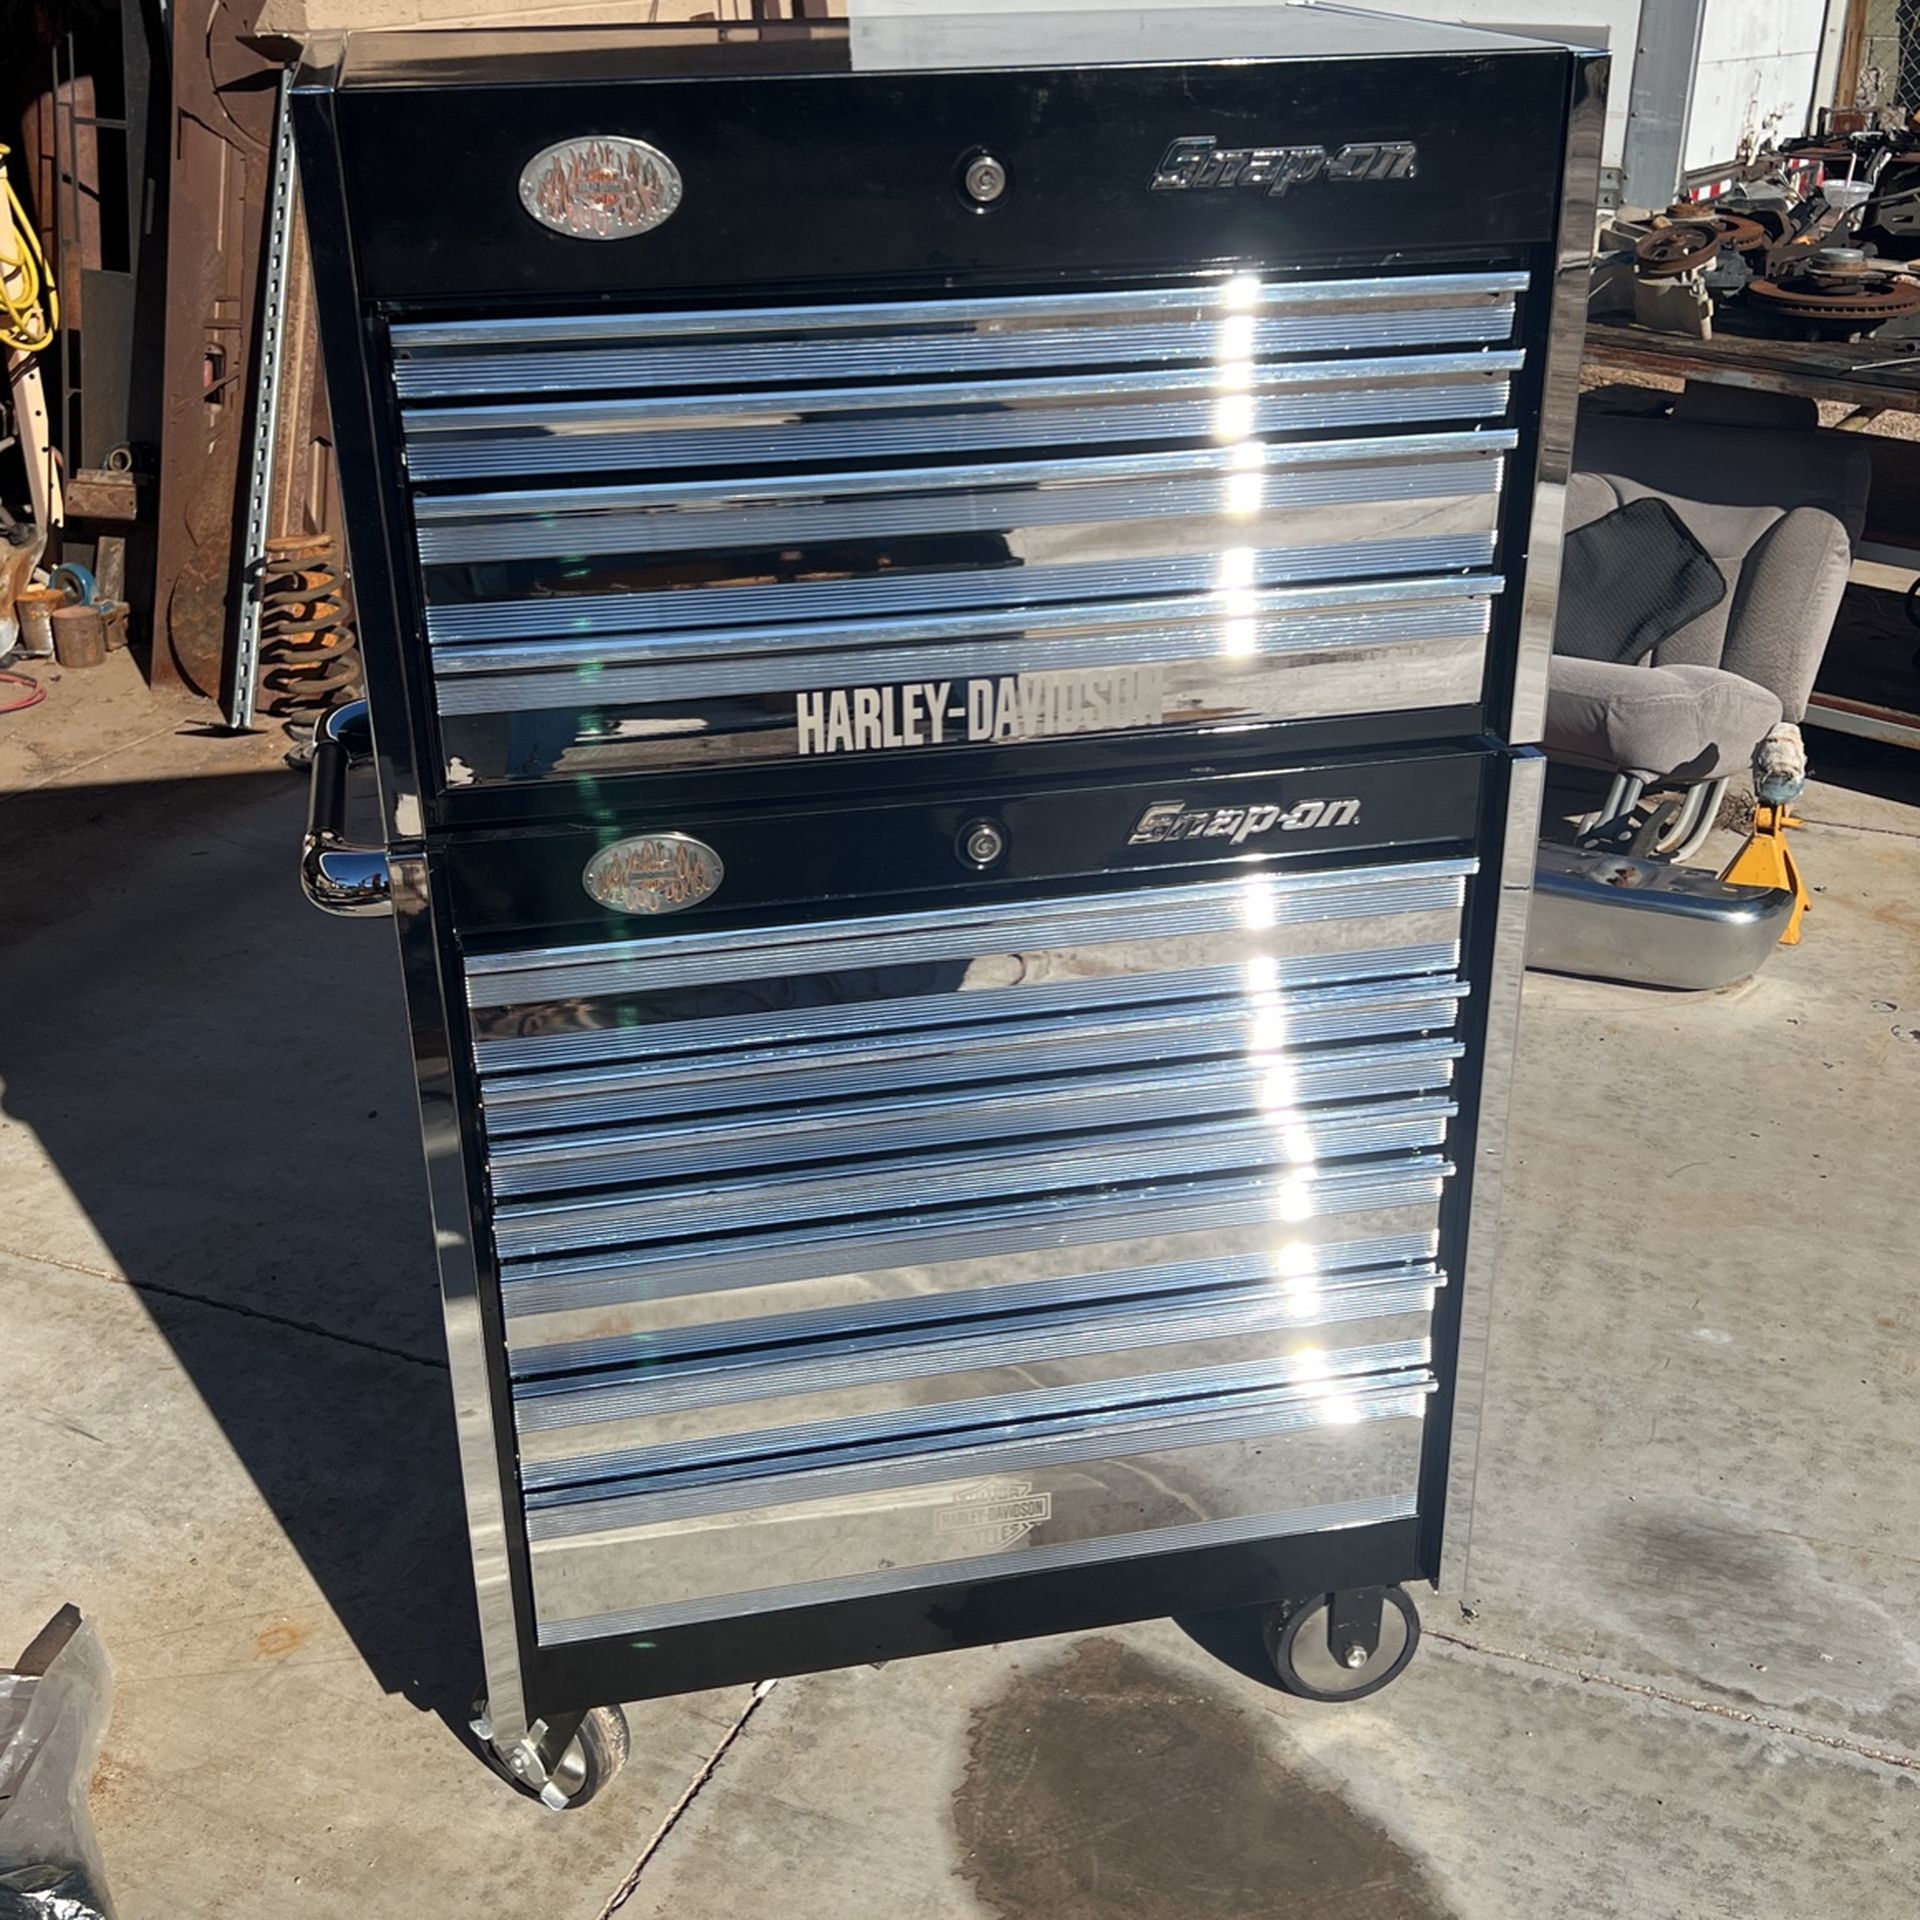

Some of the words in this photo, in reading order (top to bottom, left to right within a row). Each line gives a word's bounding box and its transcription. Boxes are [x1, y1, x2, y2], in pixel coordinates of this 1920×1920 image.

[1150, 135, 1417, 196] Snap-on
[795, 668, 1164, 755] HARLEY-DAVIDSON
[1128, 799, 1360, 845] Snap-on
